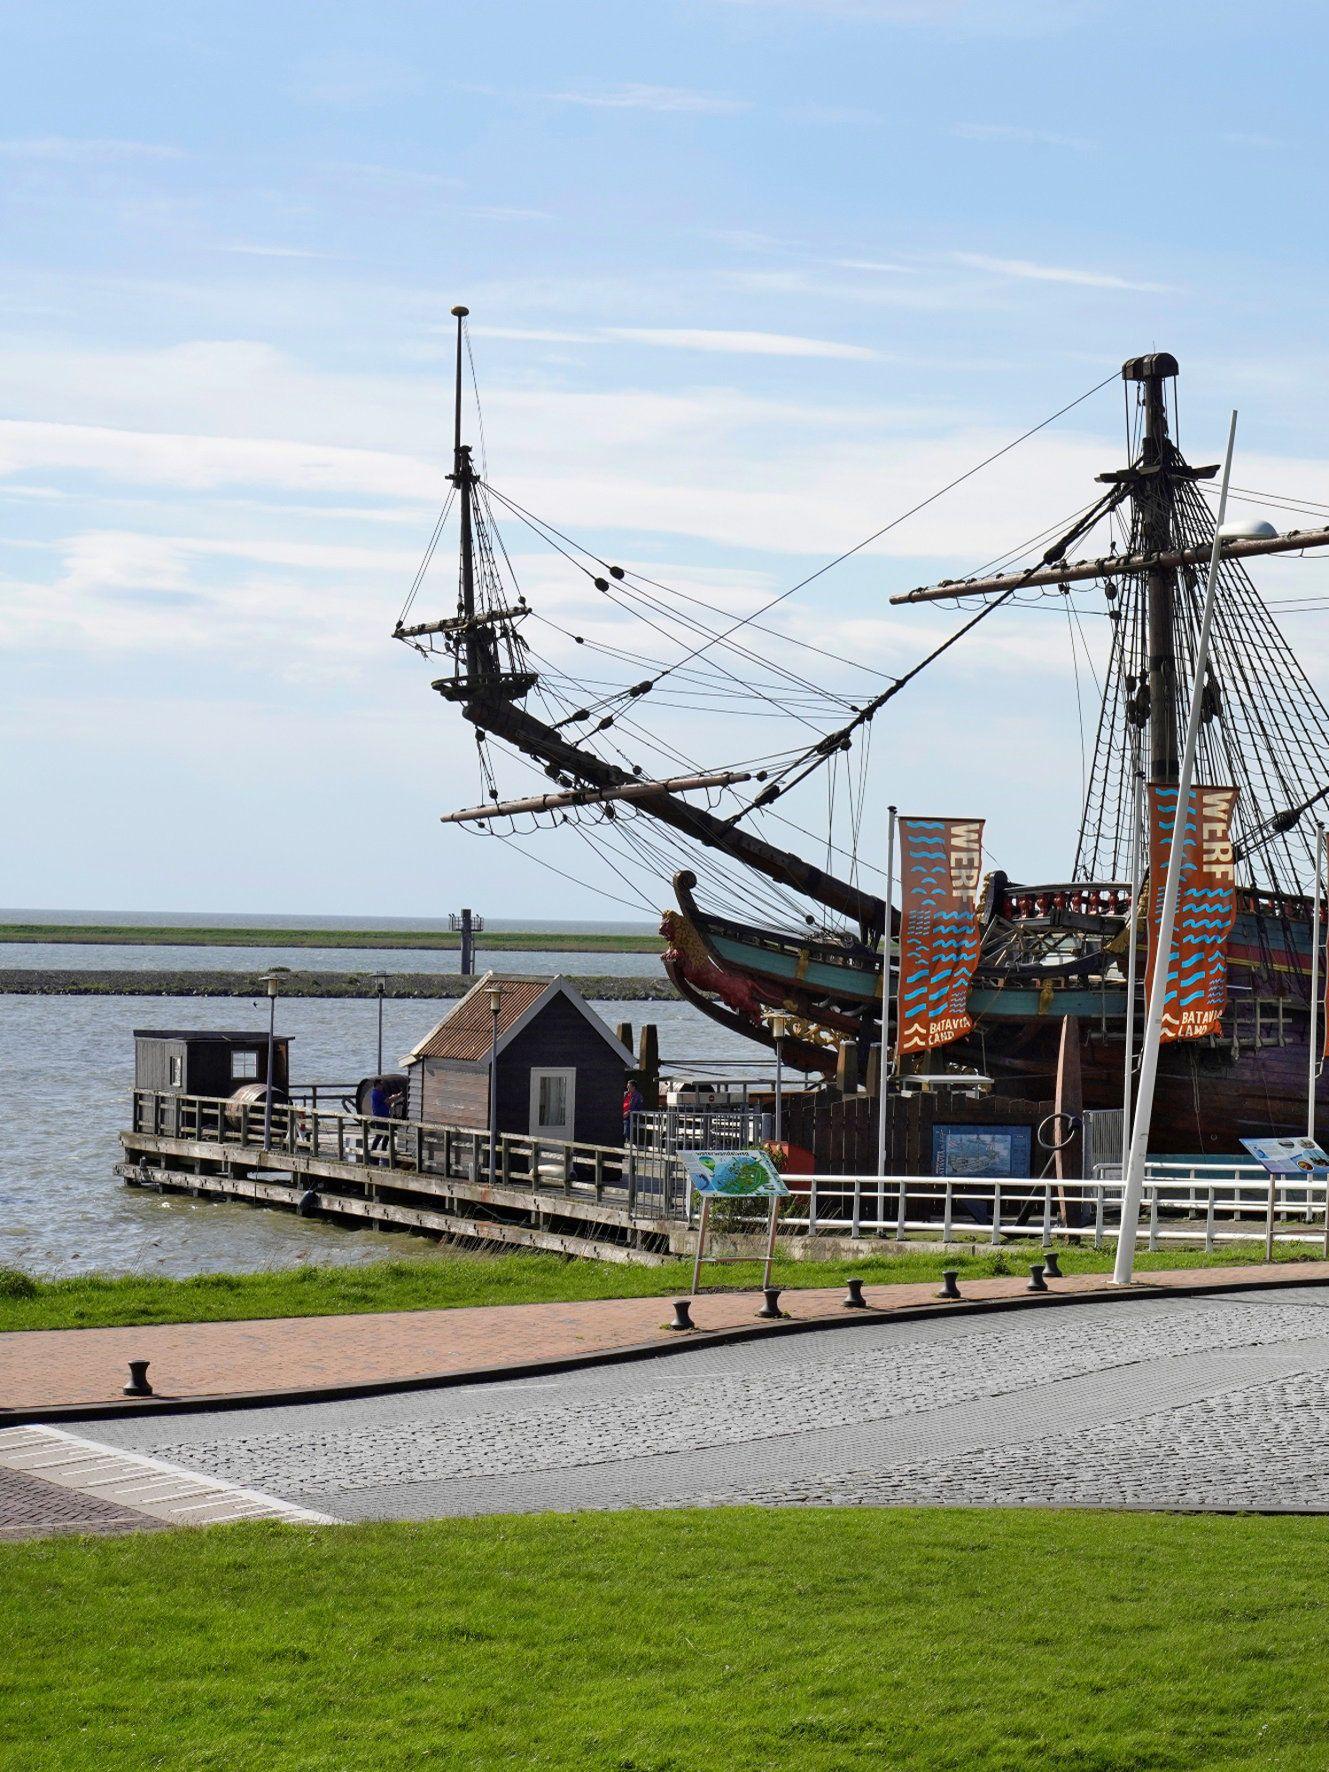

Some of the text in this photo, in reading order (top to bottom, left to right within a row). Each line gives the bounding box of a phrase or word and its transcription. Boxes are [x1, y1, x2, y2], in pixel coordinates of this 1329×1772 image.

[1203, 792, 1234, 881] WERF
[950, 823, 980, 904] WERF
[928, 1031, 955, 1045] LAND
[929, 1016, 971, 1034] BATAVIA
